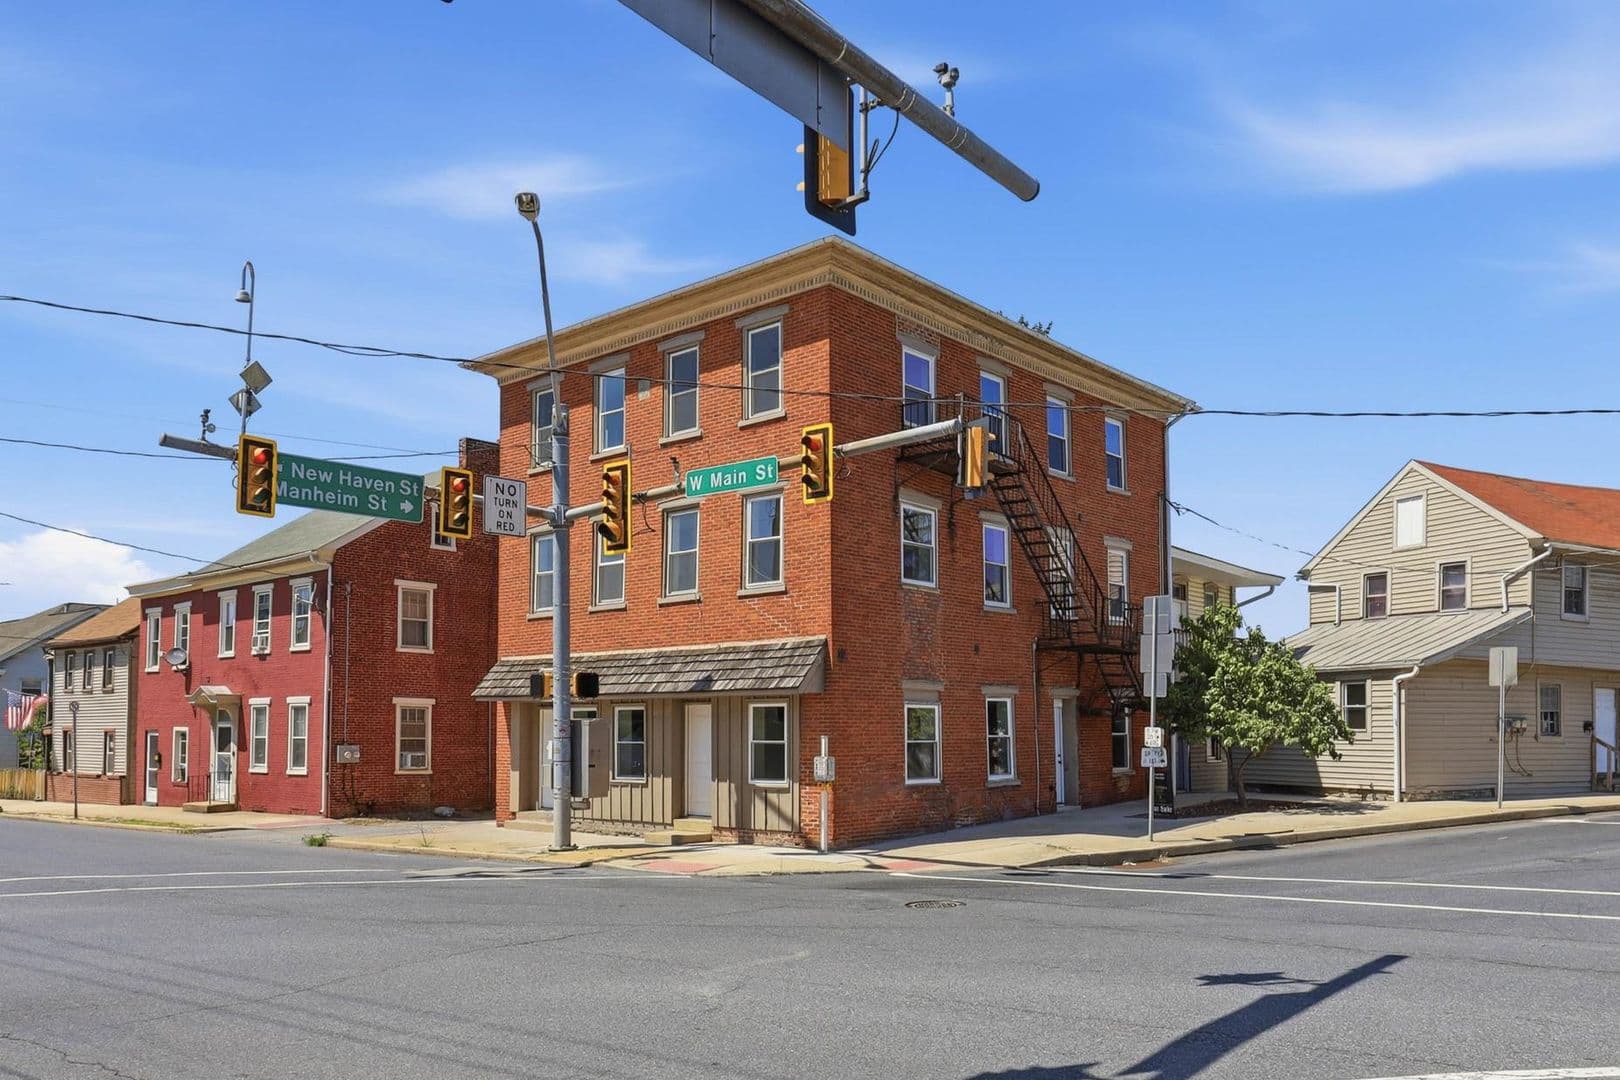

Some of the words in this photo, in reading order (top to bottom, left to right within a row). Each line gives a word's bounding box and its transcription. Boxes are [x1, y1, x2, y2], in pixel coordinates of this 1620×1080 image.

[291, 462, 333, 483] New
[339, 469, 395, 494] Haven
[399, 479, 419, 497] St
[689, 474, 703, 491] W
[710, 469, 747, 488] Main
[755, 463, 774, 480] St
[277, 480, 359, 508] Manheim
[367, 494, 388, 512] St
[495, 482, 517, 497] NO
[493, 496, 518, 508] TURN
[498, 509, 513, 520] ON
[496, 520, 515, 532] RED
